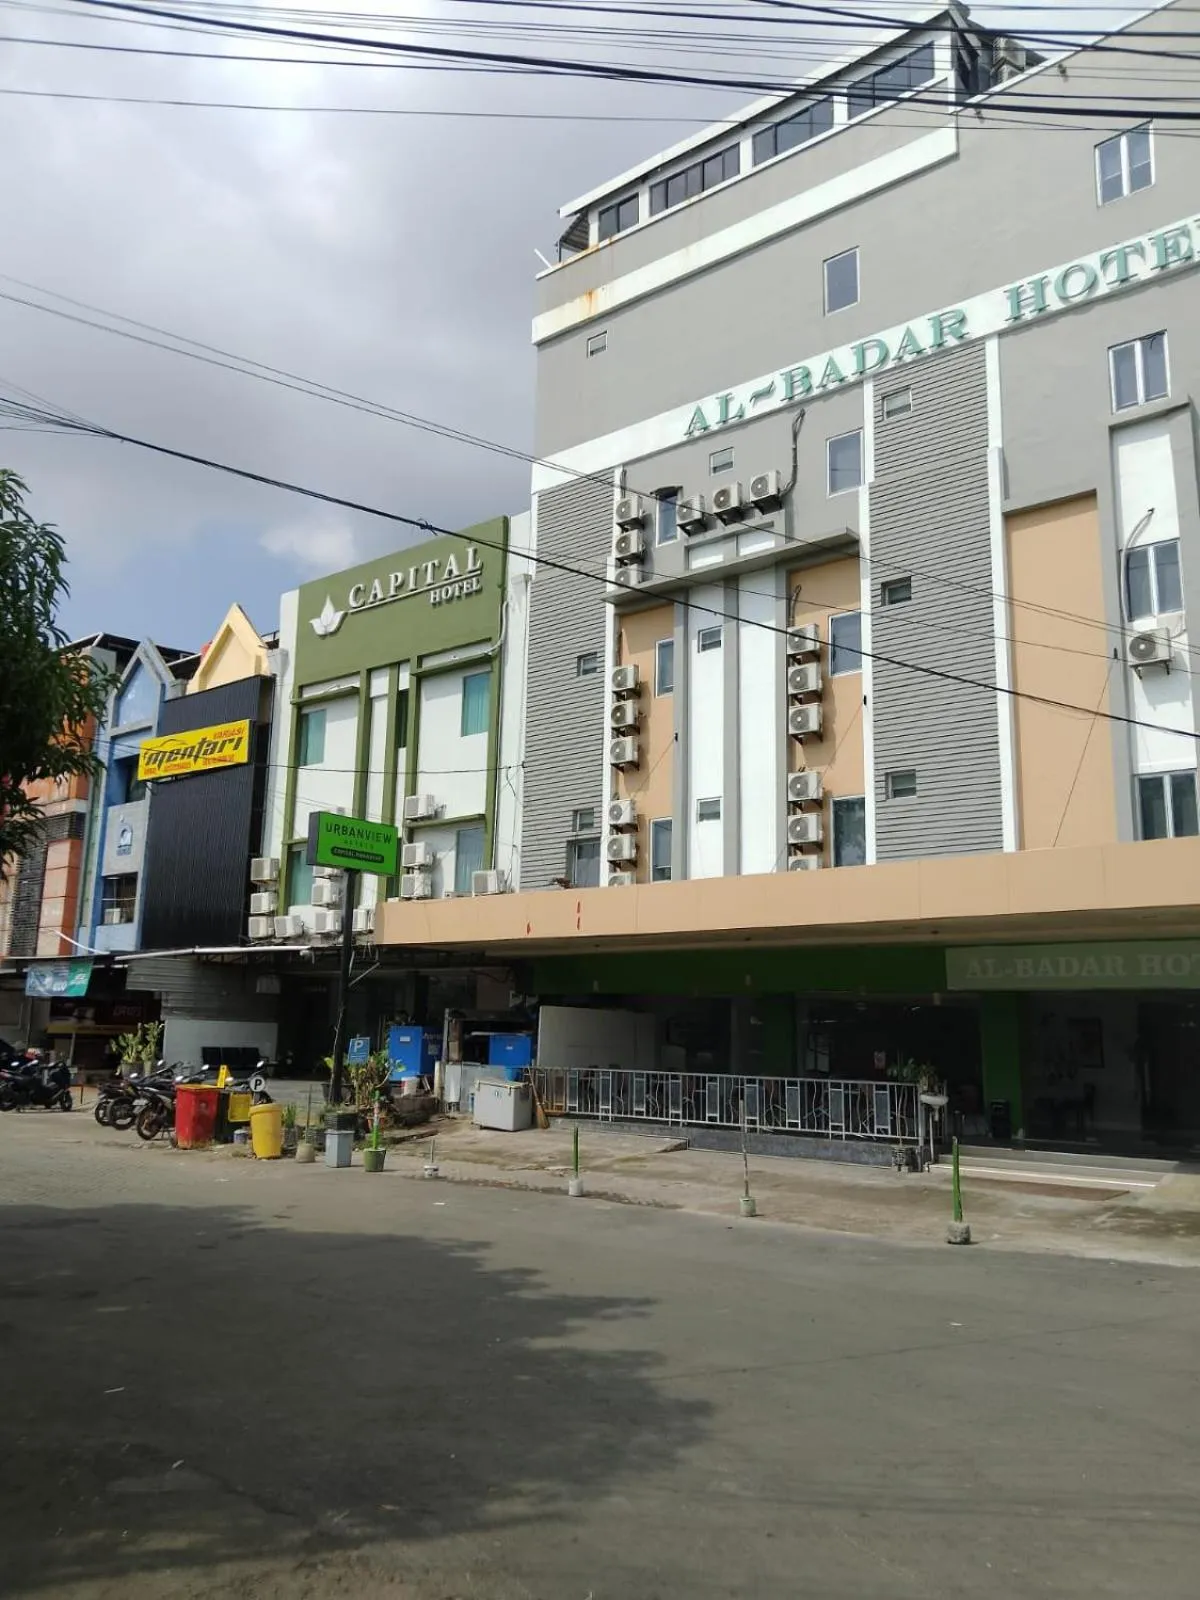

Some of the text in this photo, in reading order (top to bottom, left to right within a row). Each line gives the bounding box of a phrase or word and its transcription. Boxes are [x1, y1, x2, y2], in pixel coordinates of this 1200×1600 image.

[1004, 218, 1200, 322] HOTE
[348, 546, 483, 608] CAPITAL
[429, 577, 482, 605] HOTEL
[325, 822, 392, 844] URBANVIEW
[966, 954, 1128, 979] AL-BADAR
[353, 1039, 364, 1053] P
[253, 1078, 263, 1091] P
